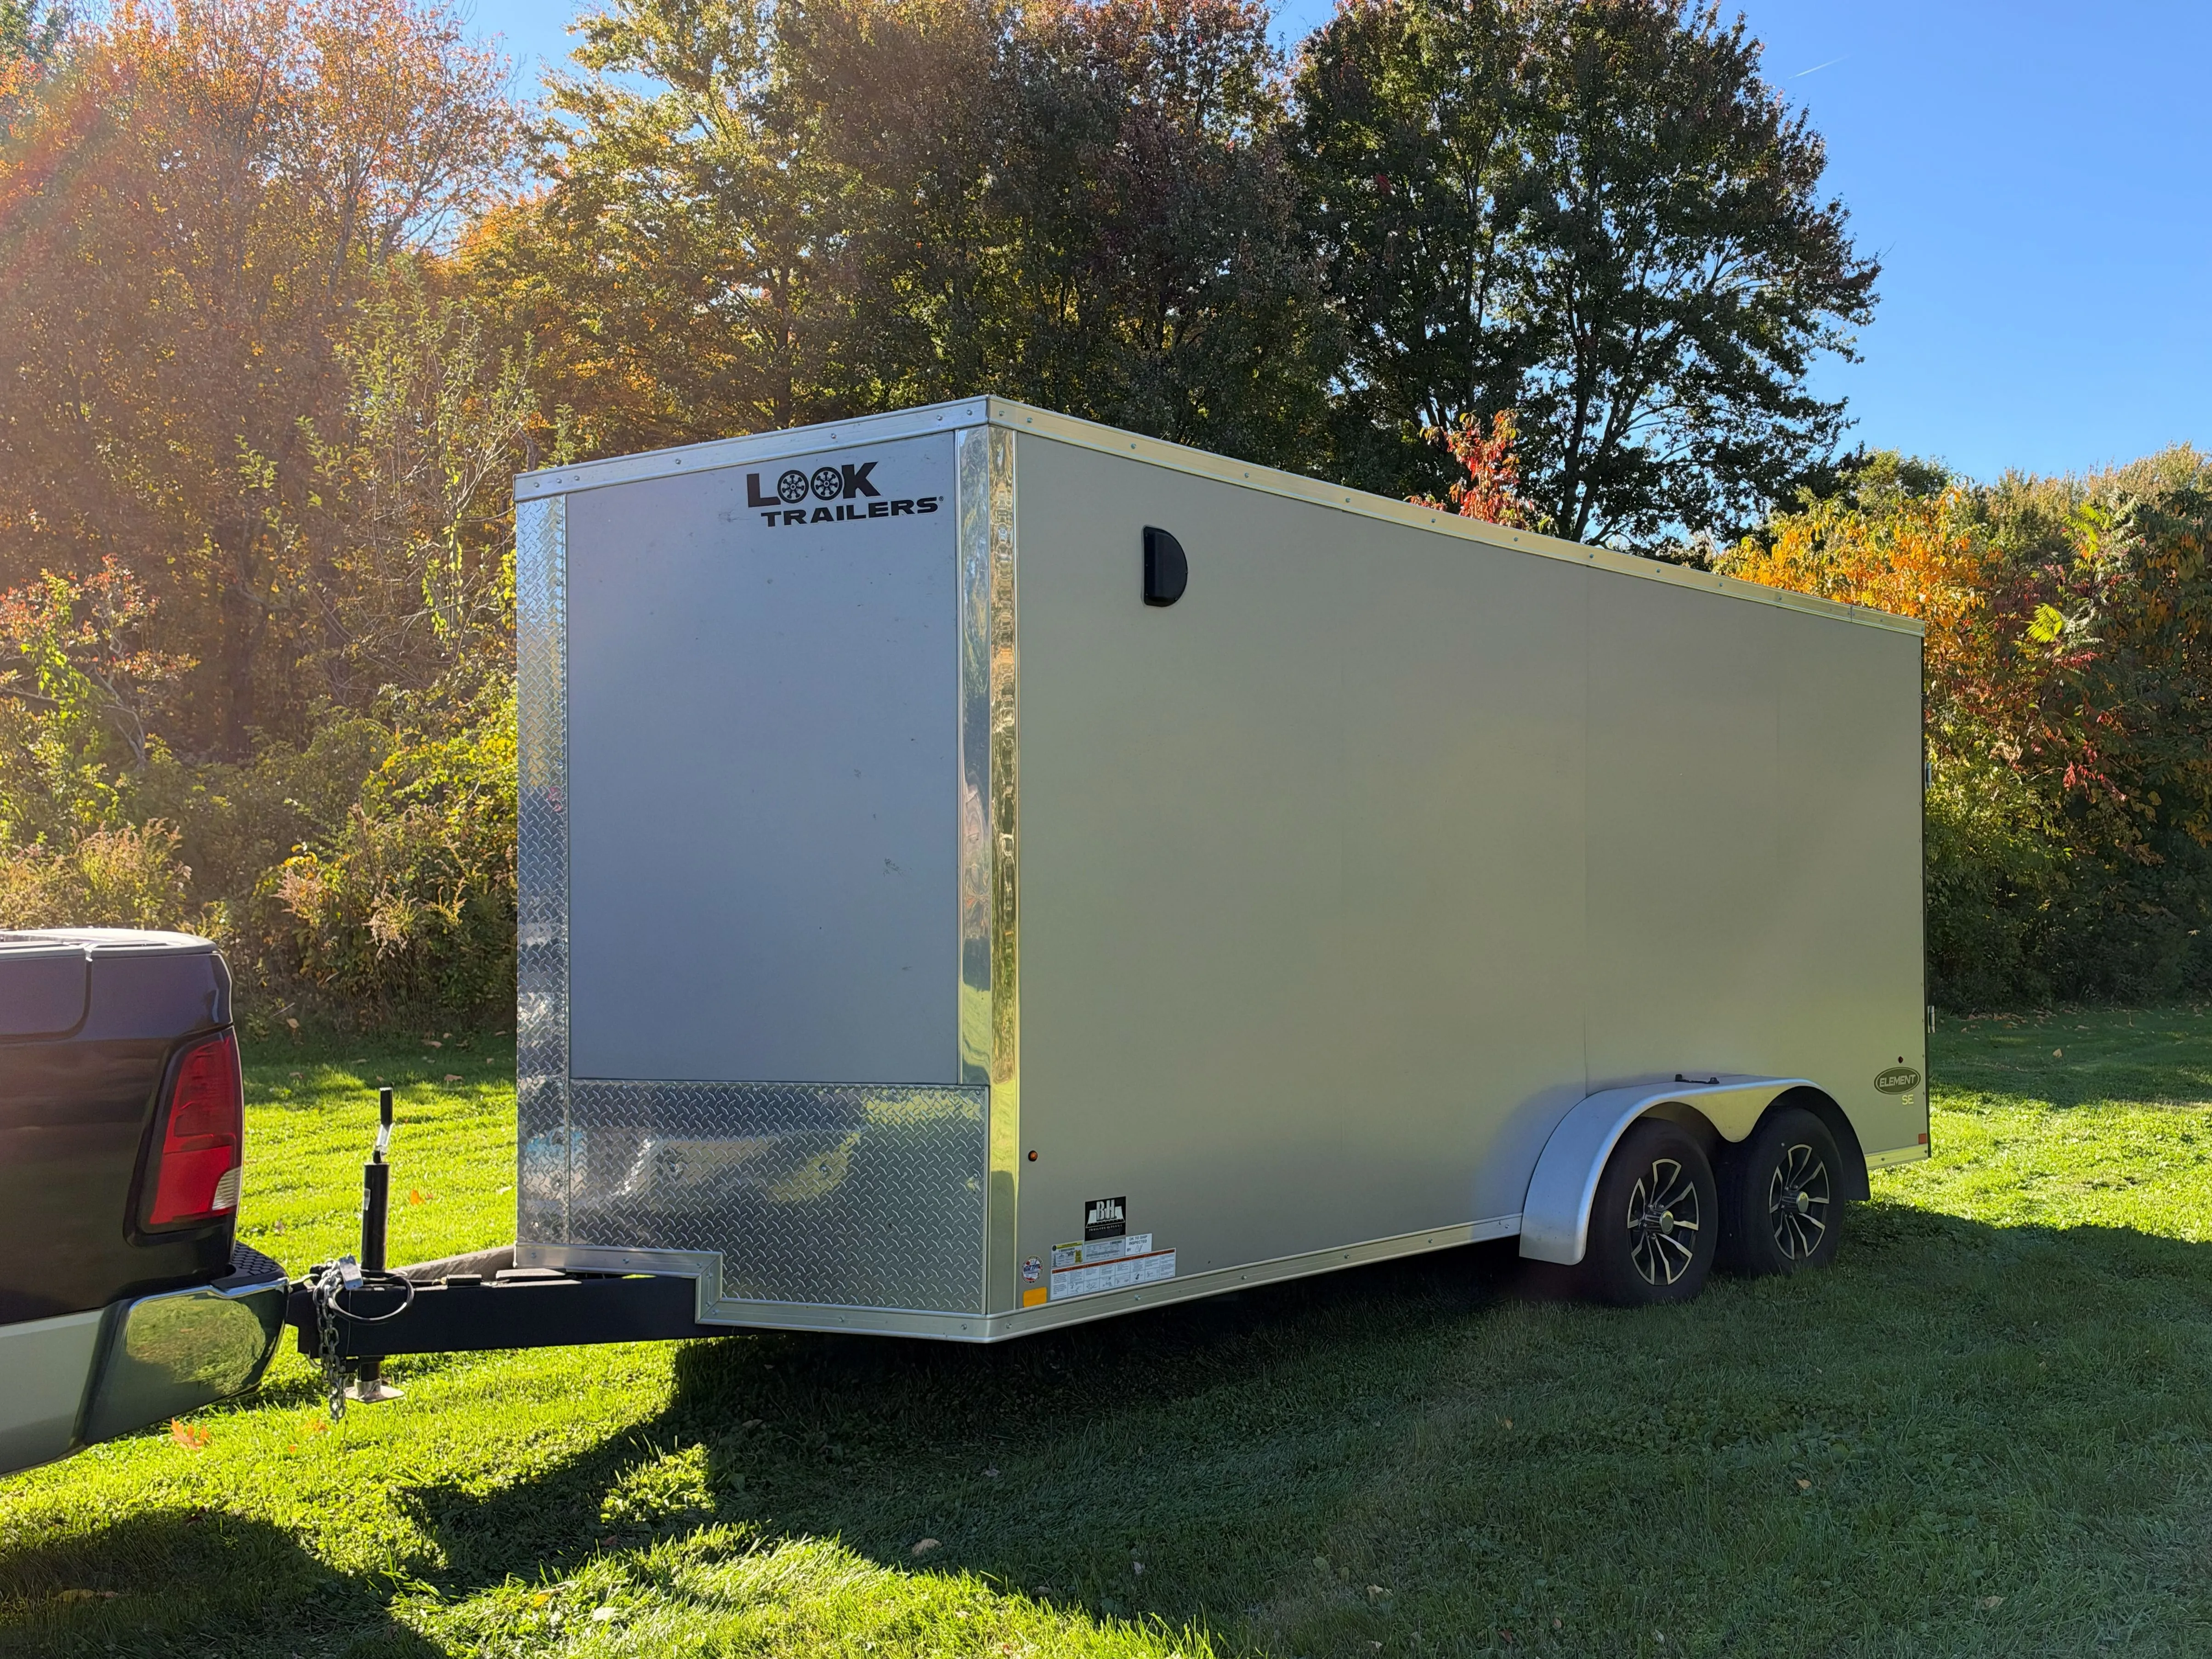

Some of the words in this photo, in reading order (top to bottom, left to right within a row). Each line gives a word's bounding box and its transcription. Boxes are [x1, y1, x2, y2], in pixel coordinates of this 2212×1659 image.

[746, 461, 882, 508] LOOK
[760, 496, 939, 527] TRAILERS
[1879, 1074, 1916, 1087] ELEMENT
[1902, 1094, 1914, 1105] SE
